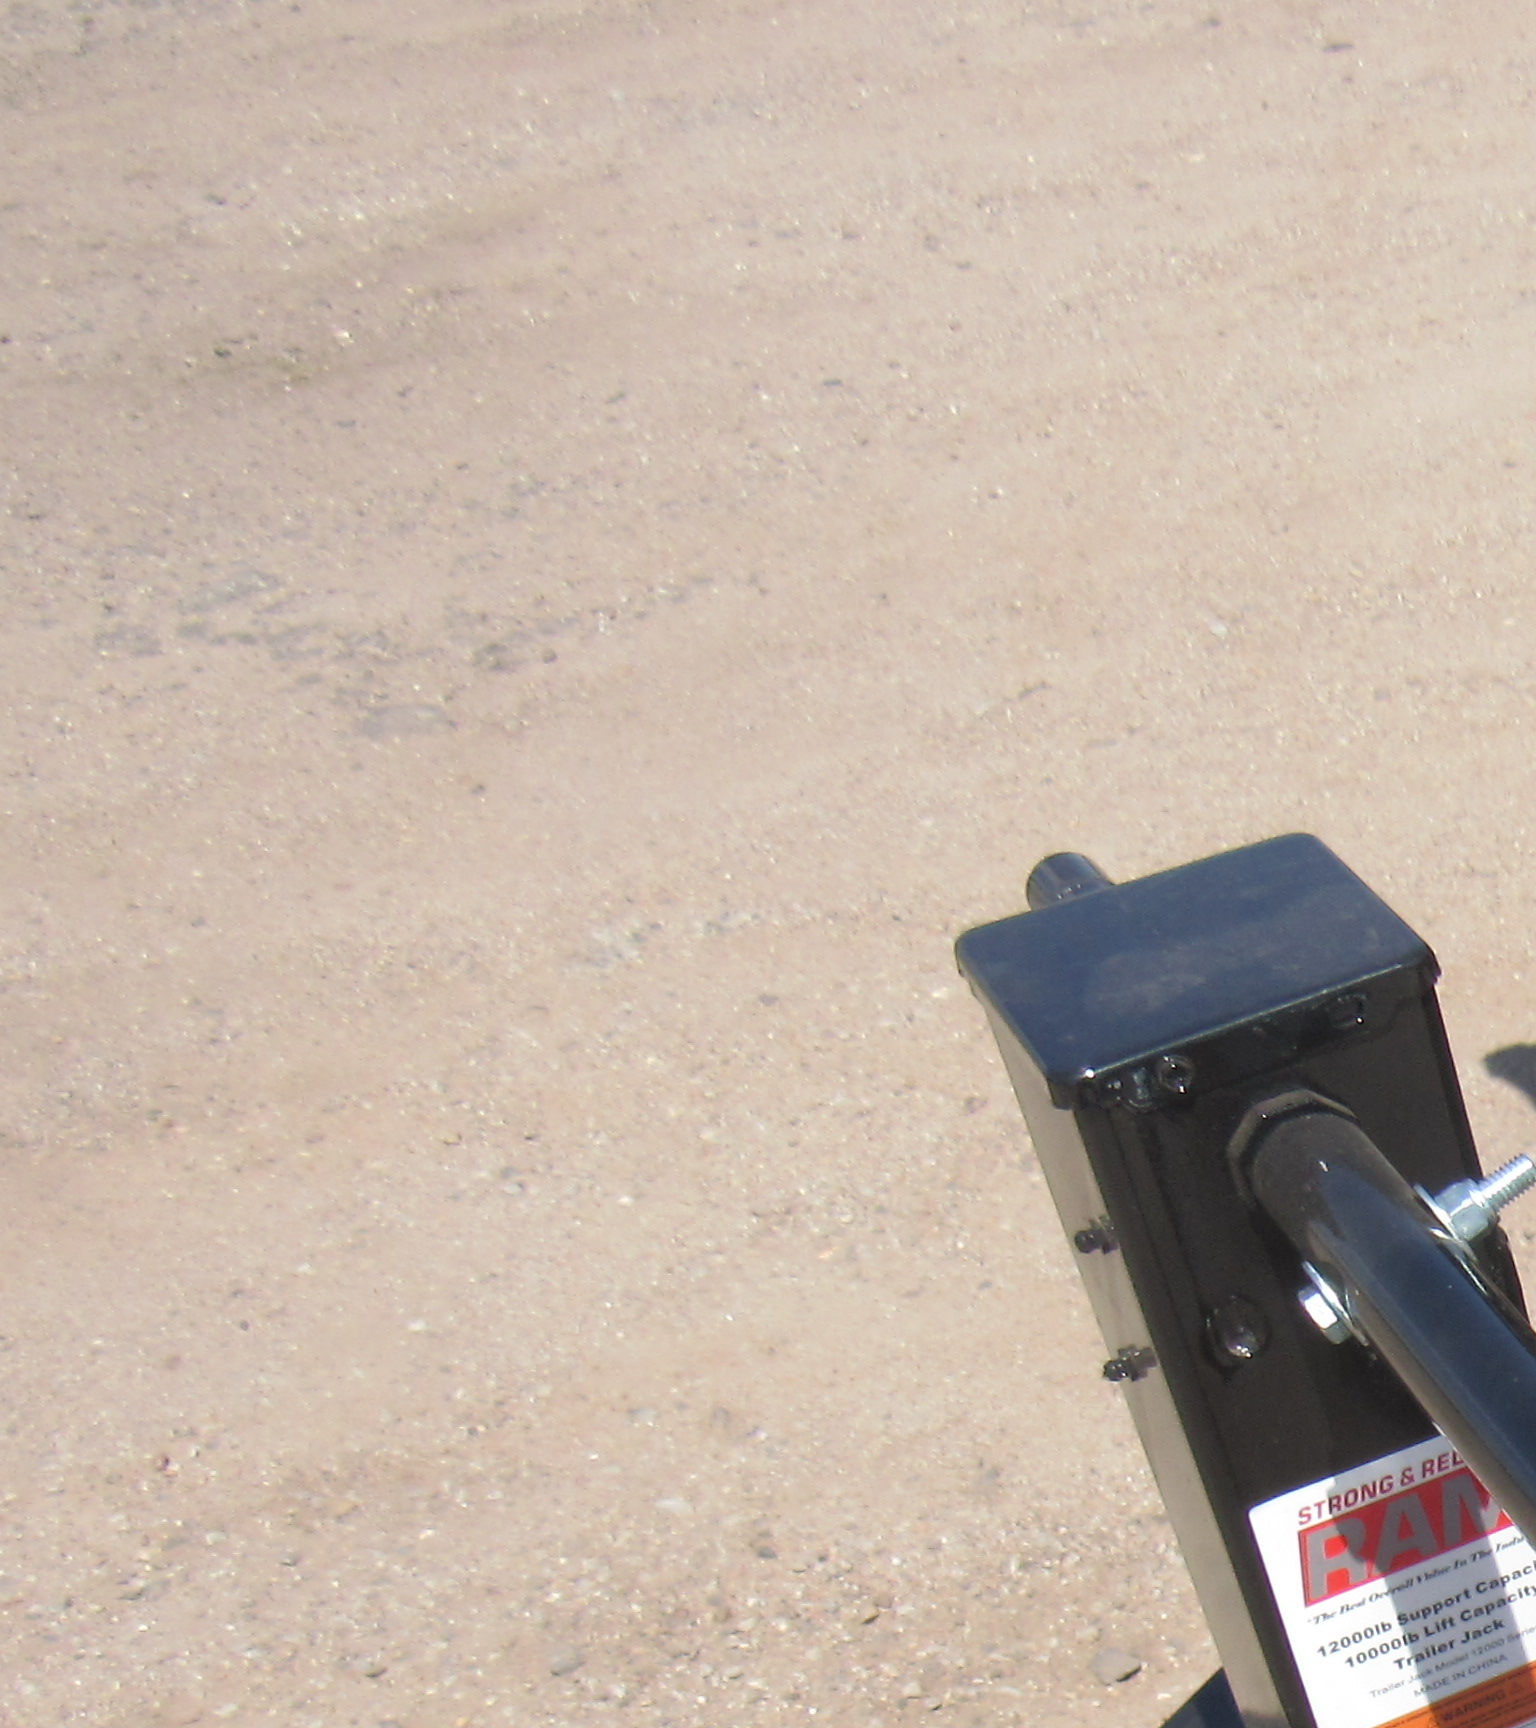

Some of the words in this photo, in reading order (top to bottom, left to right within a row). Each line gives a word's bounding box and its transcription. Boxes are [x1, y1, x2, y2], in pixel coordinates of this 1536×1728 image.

[1298, 1476, 1394, 1525] STRONG
[1401, 1467, 1414, 1487] &
[1317, 1623, 1392, 1657] 12000lb
[1397, 1590, 1470, 1625] Support
[1344, 1632, 1419, 1668] 10000lb
[1424, 1616, 1456, 1638] Lift
[1393, 1641, 1455, 1670] Trailer
[1461, 1619, 1505, 1644] Jack
[1413, 1677, 1450, 1697] MADE
[1468, 1654, 1508, 1674] CHINA
